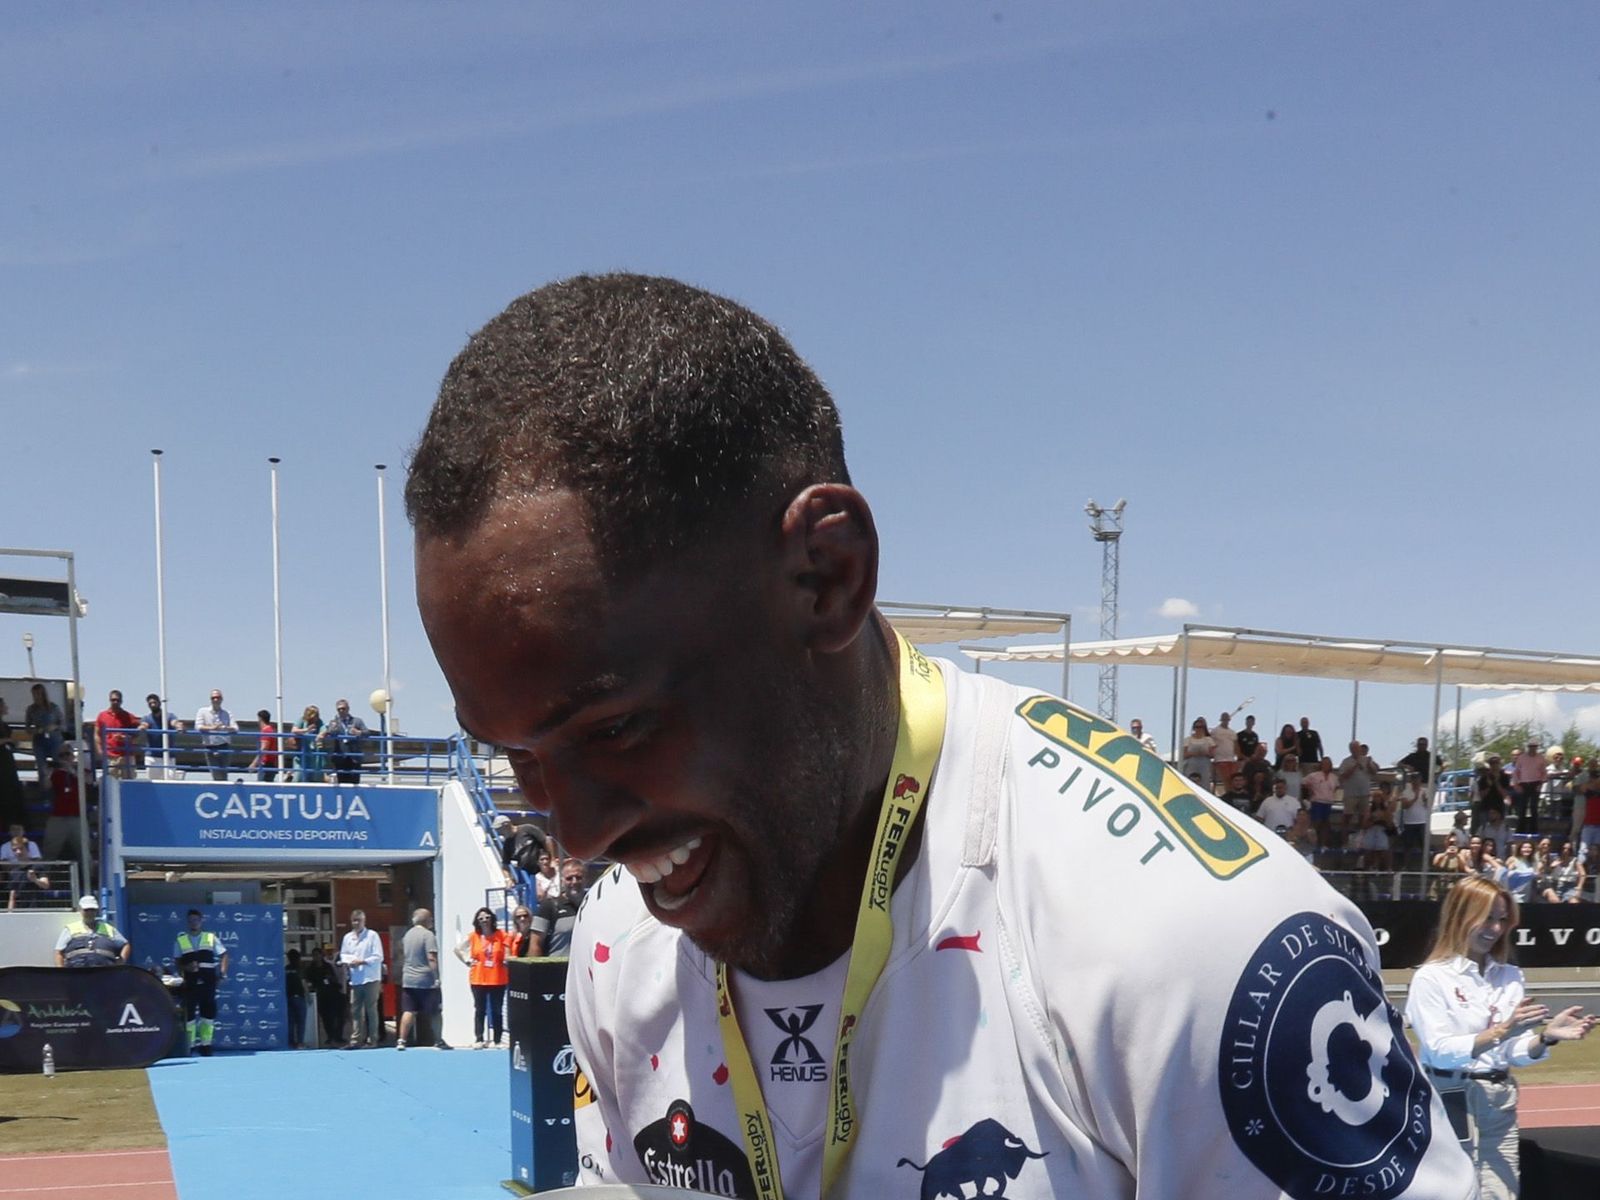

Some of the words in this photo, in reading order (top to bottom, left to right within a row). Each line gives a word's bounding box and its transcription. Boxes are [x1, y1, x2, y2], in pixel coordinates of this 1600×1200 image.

[195, 792, 371, 821] CARTUJA
[1028, 747, 1176, 866] PIVOT
[200, 829, 292, 840] INSTALACIONES
[294, 830, 368, 841] DEPORTIVAS
[874, 806, 911, 912] FERugby
[1516, 928, 1600, 946] LVO
[1231, 962, 1283, 1090] CILLAR
[1281, 924, 1318, 960] DE
[837, 1042, 855, 1143] FERugby
[644, 1147, 737, 1198] Estrella
[1314, 1155, 1406, 1195] DESDE
